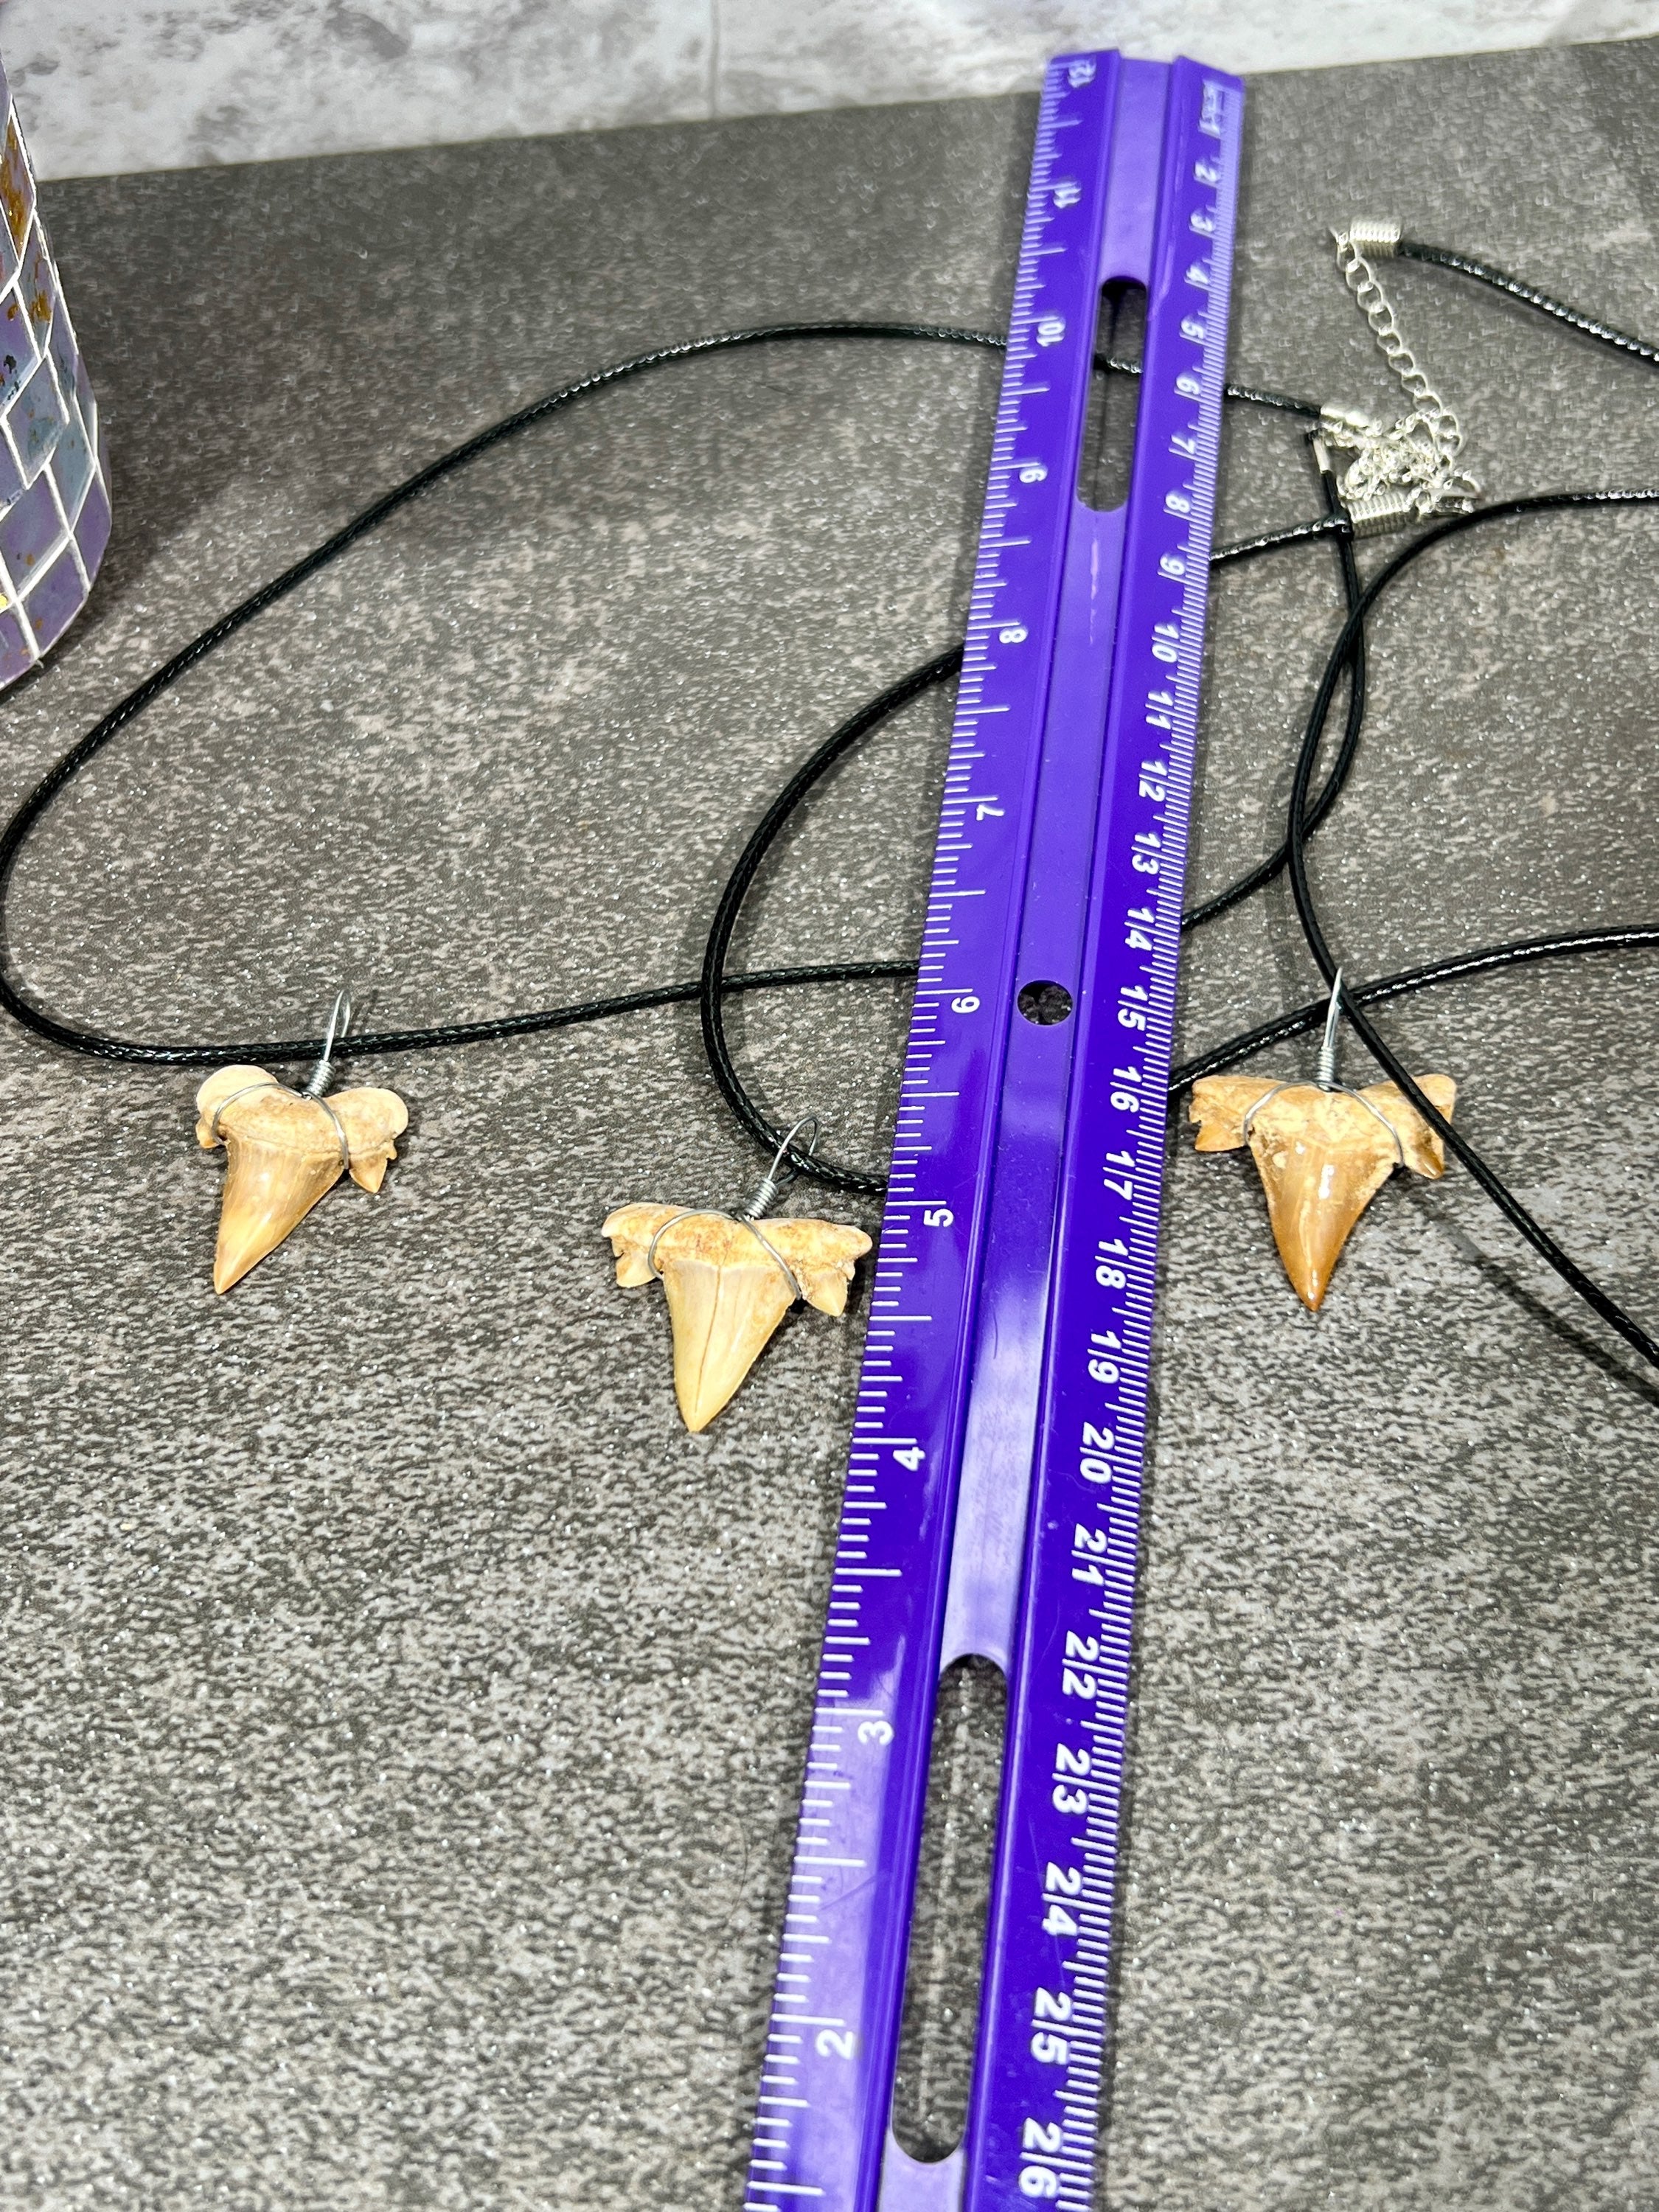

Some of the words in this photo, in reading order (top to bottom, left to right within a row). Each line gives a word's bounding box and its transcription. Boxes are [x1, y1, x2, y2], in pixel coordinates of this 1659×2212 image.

[1068, 59, 1096, 88] 12
[1194, 161, 1218, 181] 2
[1053, 181, 1081, 208] 11
[1189, 212, 1214, 232] 3
[1186, 262, 1211, 284] 4
[1036, 318, 1065, 347] 10
[1180, 314, 1206, 338] 5
[1176, 373, 1200, 394] 6
[1171, 433, 1196, 455] 7
[1019, 465, 1048, 483] 9
[1165, 490, 1191, 513] 8
[1160, 553, 1186, 575] 9
[998, 628, 1028, 644] 8
[1152, 623, 1179, 663] 10
[1145, 691, 1174, 729] 11
[1138, 760, 1168, 802] 12
[975, 804, 1005, 821] 7
[1131, 832, 1161, 875] 13
[1124, 907, 1155, 951] 14
[950, 996, 981, 1014] 6
[1117, 985, 1148, 1031] 15
[1110, 1065, 1142, 1113] 16
[1103, 1151, 1135, 1200] 17
[923, 1208, 954, 1227] 5
[1095, 1238, 1128, 1290] 18
[1088, 1330, 1121, 1384] 19
[892, 1446, 925, 1472] 4
[1079, 1422, 1115, 1484] 20
[1071, 1523, 1107, 1587] 21
[1062, 1630, 1099, 1700] 22
[858, 1719, 894, 1745] 3
[1052, 1742, 1091, 1815] 23
[1041, 1862, 1082, 1937] 24
[1031, 1986, 1072, 2065] 25
[815, 2029, 855, 2059] 2
[1018, 2117, 1062, 2199] 26
